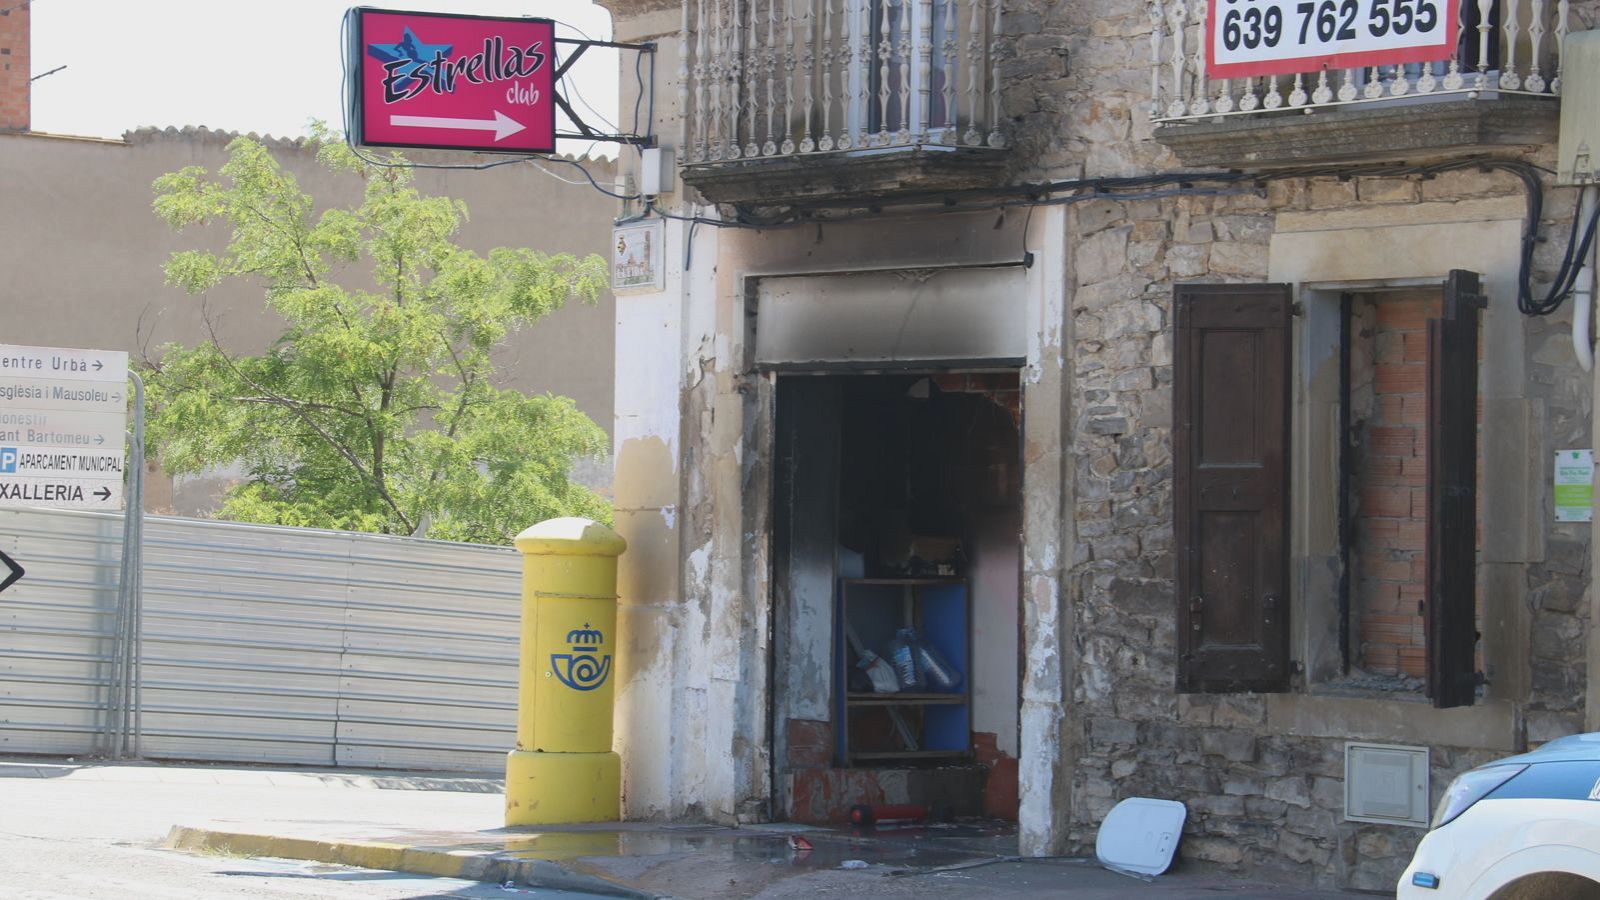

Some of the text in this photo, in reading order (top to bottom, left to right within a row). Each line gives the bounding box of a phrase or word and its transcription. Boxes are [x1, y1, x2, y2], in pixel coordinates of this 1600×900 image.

[1223, 0, 1438, 51] 639 762 555
[381, 36, 546, 104] Estrellas
[506, 80, 540, 106] club
[46, 385, 49, 399] i
[53, 386, 108, 402] Mausoleu
[0, 414, 48, 426] onestir
[27, 429, 90, 444] Bartomeu
[2, 452, 122, 472] P APARCAMENT MUNICIPAL
